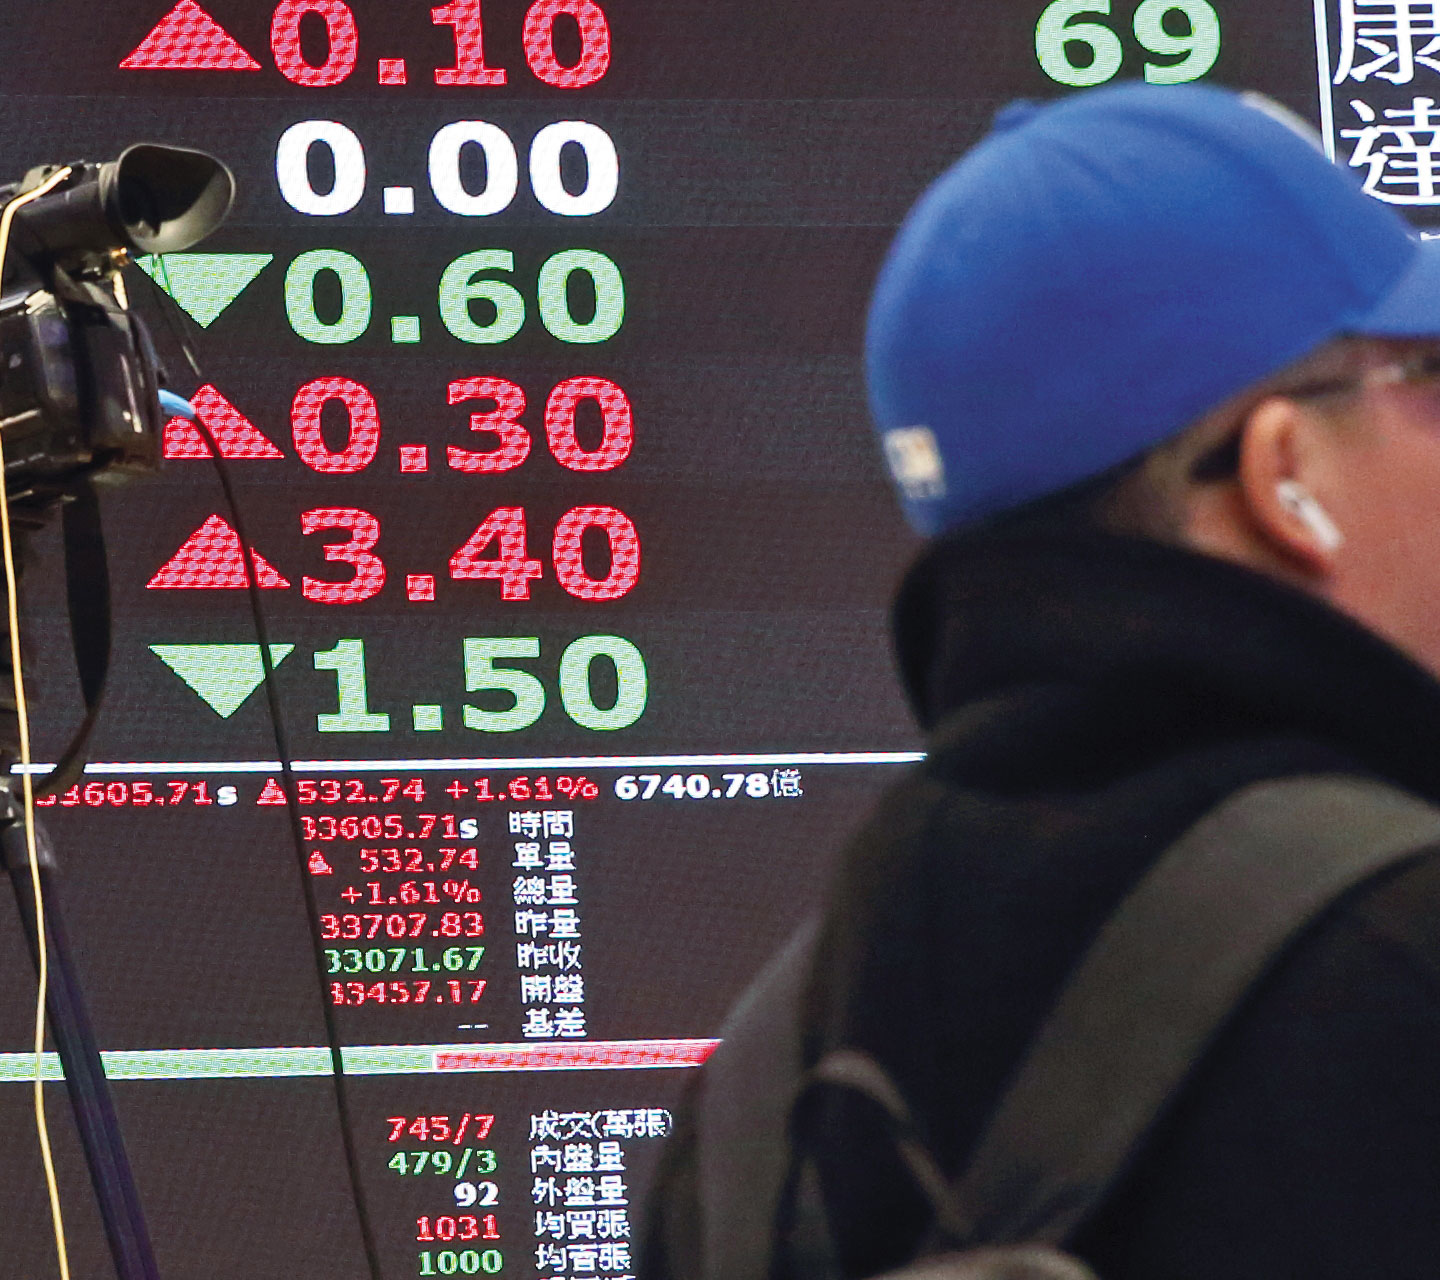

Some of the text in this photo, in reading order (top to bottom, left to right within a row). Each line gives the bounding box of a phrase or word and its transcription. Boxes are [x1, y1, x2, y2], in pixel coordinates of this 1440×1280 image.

[277, 120, 618, 216] 0.00
[285, 249, 624, 344] 0.60
[290, 376, 634, 474] 0.30
[300, 504, 641, 605] 3.40
[314, 635, 648, 732] 1.50
[296, 778, 426, 805] 532.74
[445, 776, 599, 802] +1.61%
[360, 848, 479, 873] 532.74
[341, 879, 482, 905] +1.61%
[320, 912, 484, 939] 33707.83
[387, 1113, 495, 1145] 745/7
[389, 1148, 496, 1179] 479/3
[454, 1181, 498, 1206] 92
[417, 1214, 500, 1241] 1031
[419, 1250, 502, 1275] 1000
